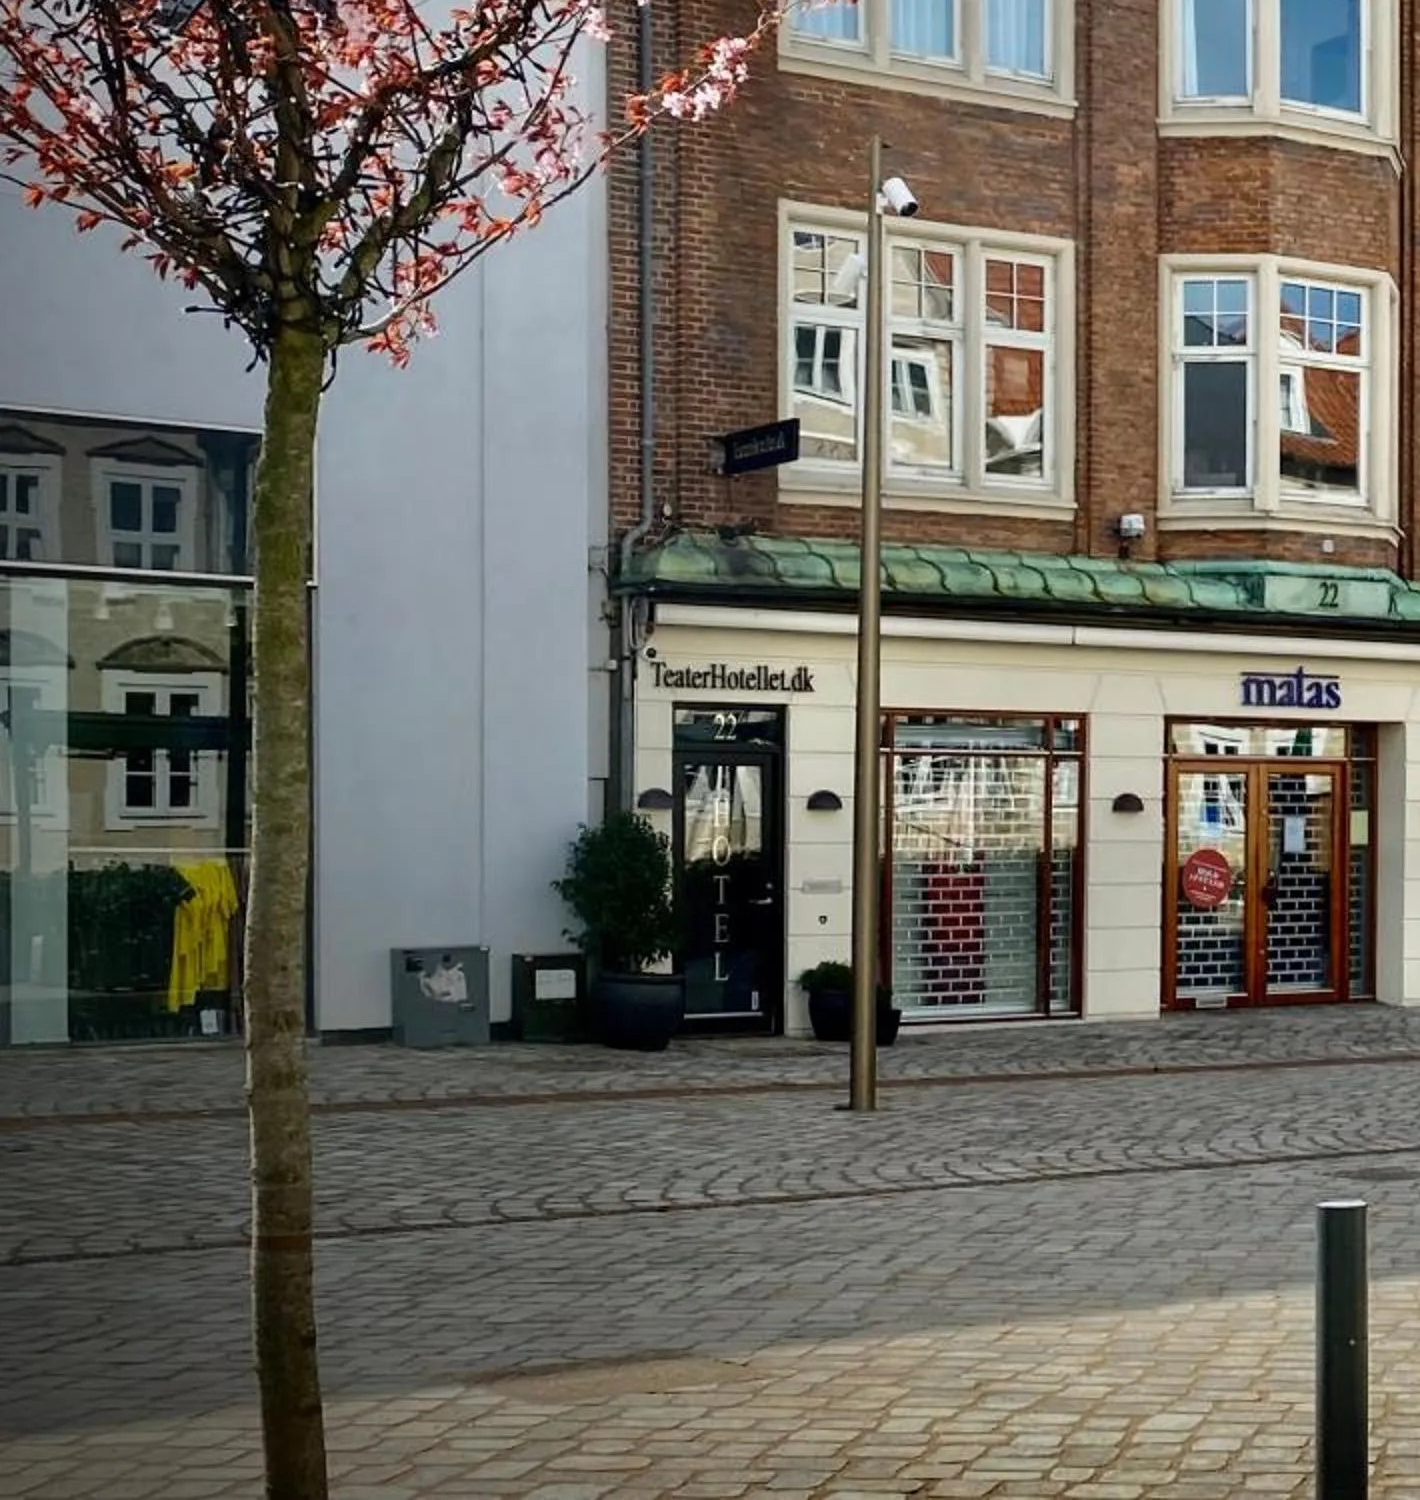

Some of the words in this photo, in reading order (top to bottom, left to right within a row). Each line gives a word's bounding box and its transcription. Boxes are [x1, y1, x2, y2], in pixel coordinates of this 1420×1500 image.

[1318, 581, 1339, 608] 22
[650, 661, 815, 693] TeaterHotellet.dk
[1241, 665, 1341, 709] matas
[713, 713, 737, 741] 22
